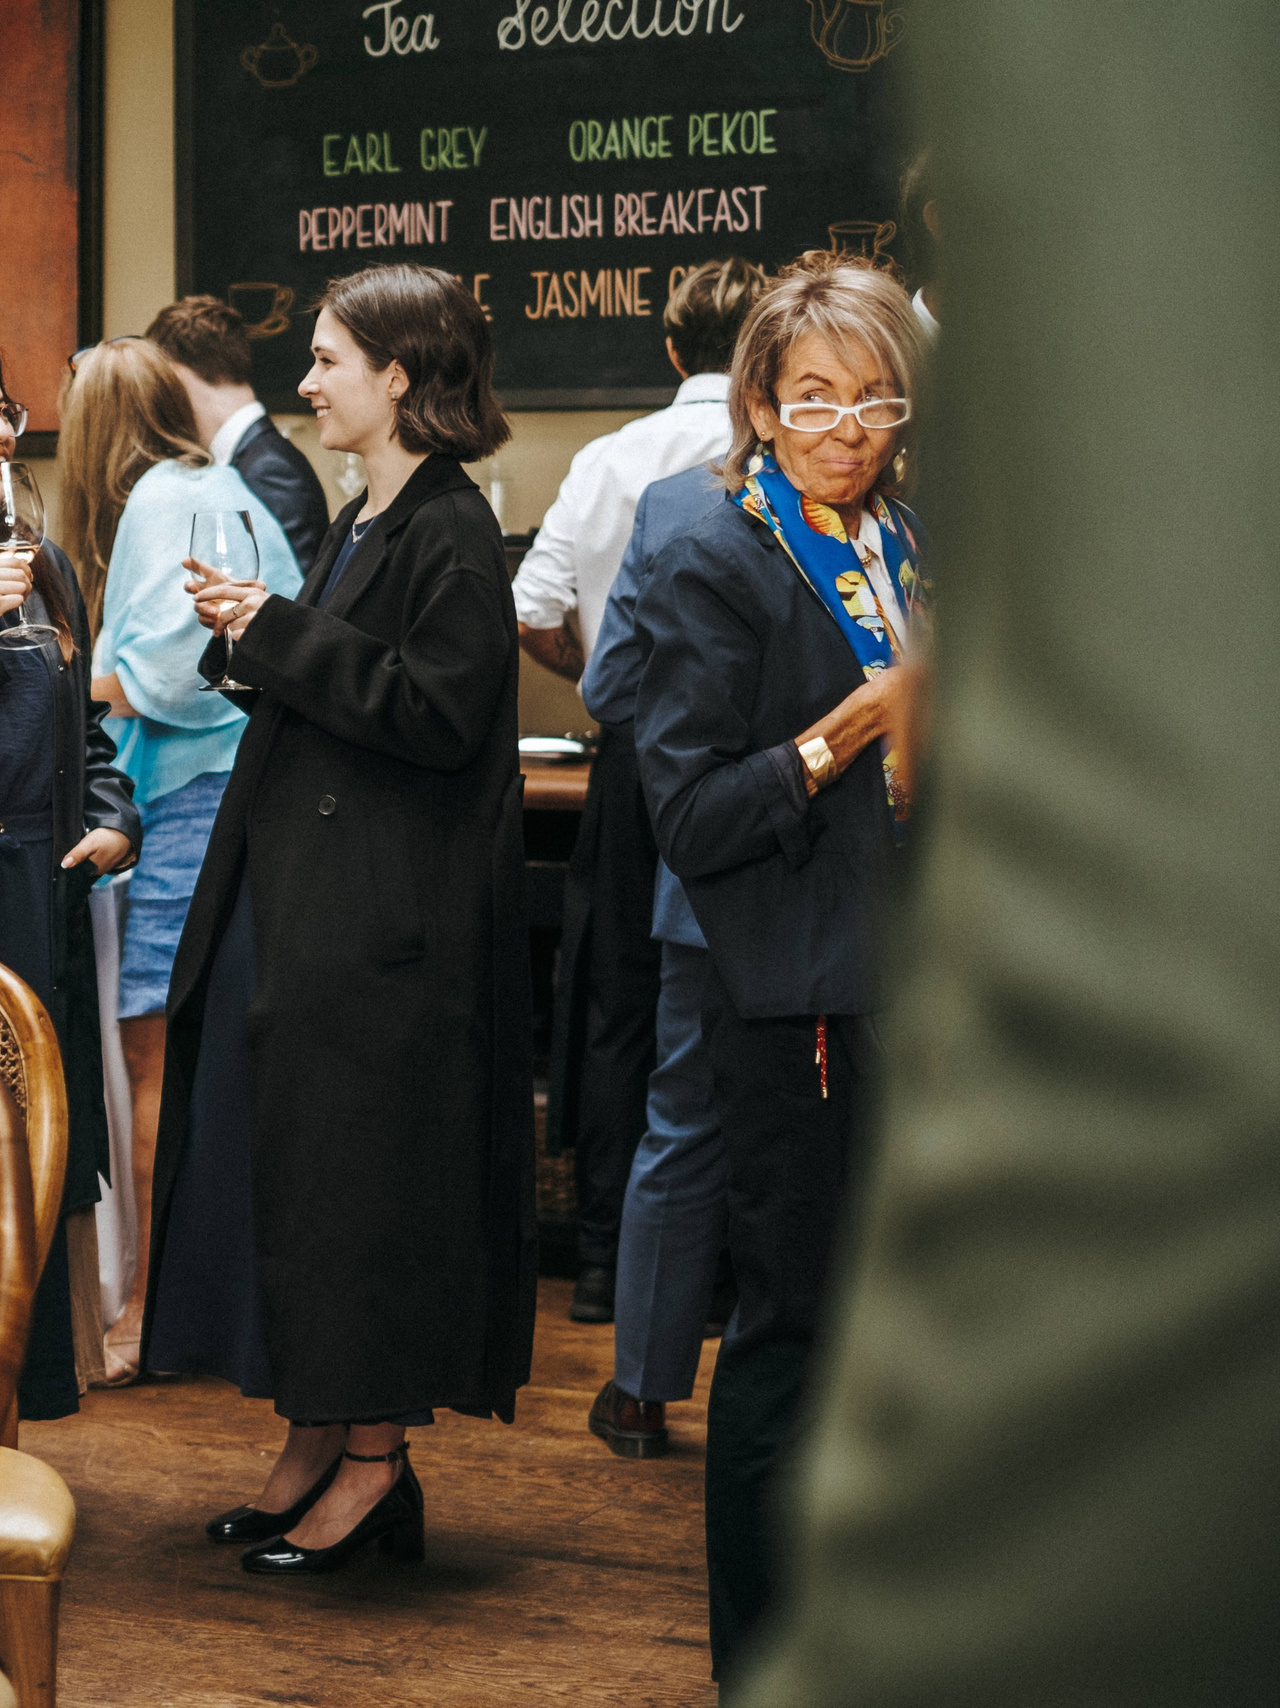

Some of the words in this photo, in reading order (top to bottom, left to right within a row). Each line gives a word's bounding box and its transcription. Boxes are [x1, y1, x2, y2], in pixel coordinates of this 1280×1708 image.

[362, 0, 440, 57] Tea
[322, 131, 402, 176] EARL
[421, 126, 488, 172] GREY
[570, 115, 673, 162] ORANGE
[688, 108, 778, 156] PEKOE
[299, 200, 454, 251] PEPPERMINT
[490, 194, 603, 241] ENGLISH
[614, 185, 767, 237] BREAKFAST
[525, 267, 652, 320] JASMINE
